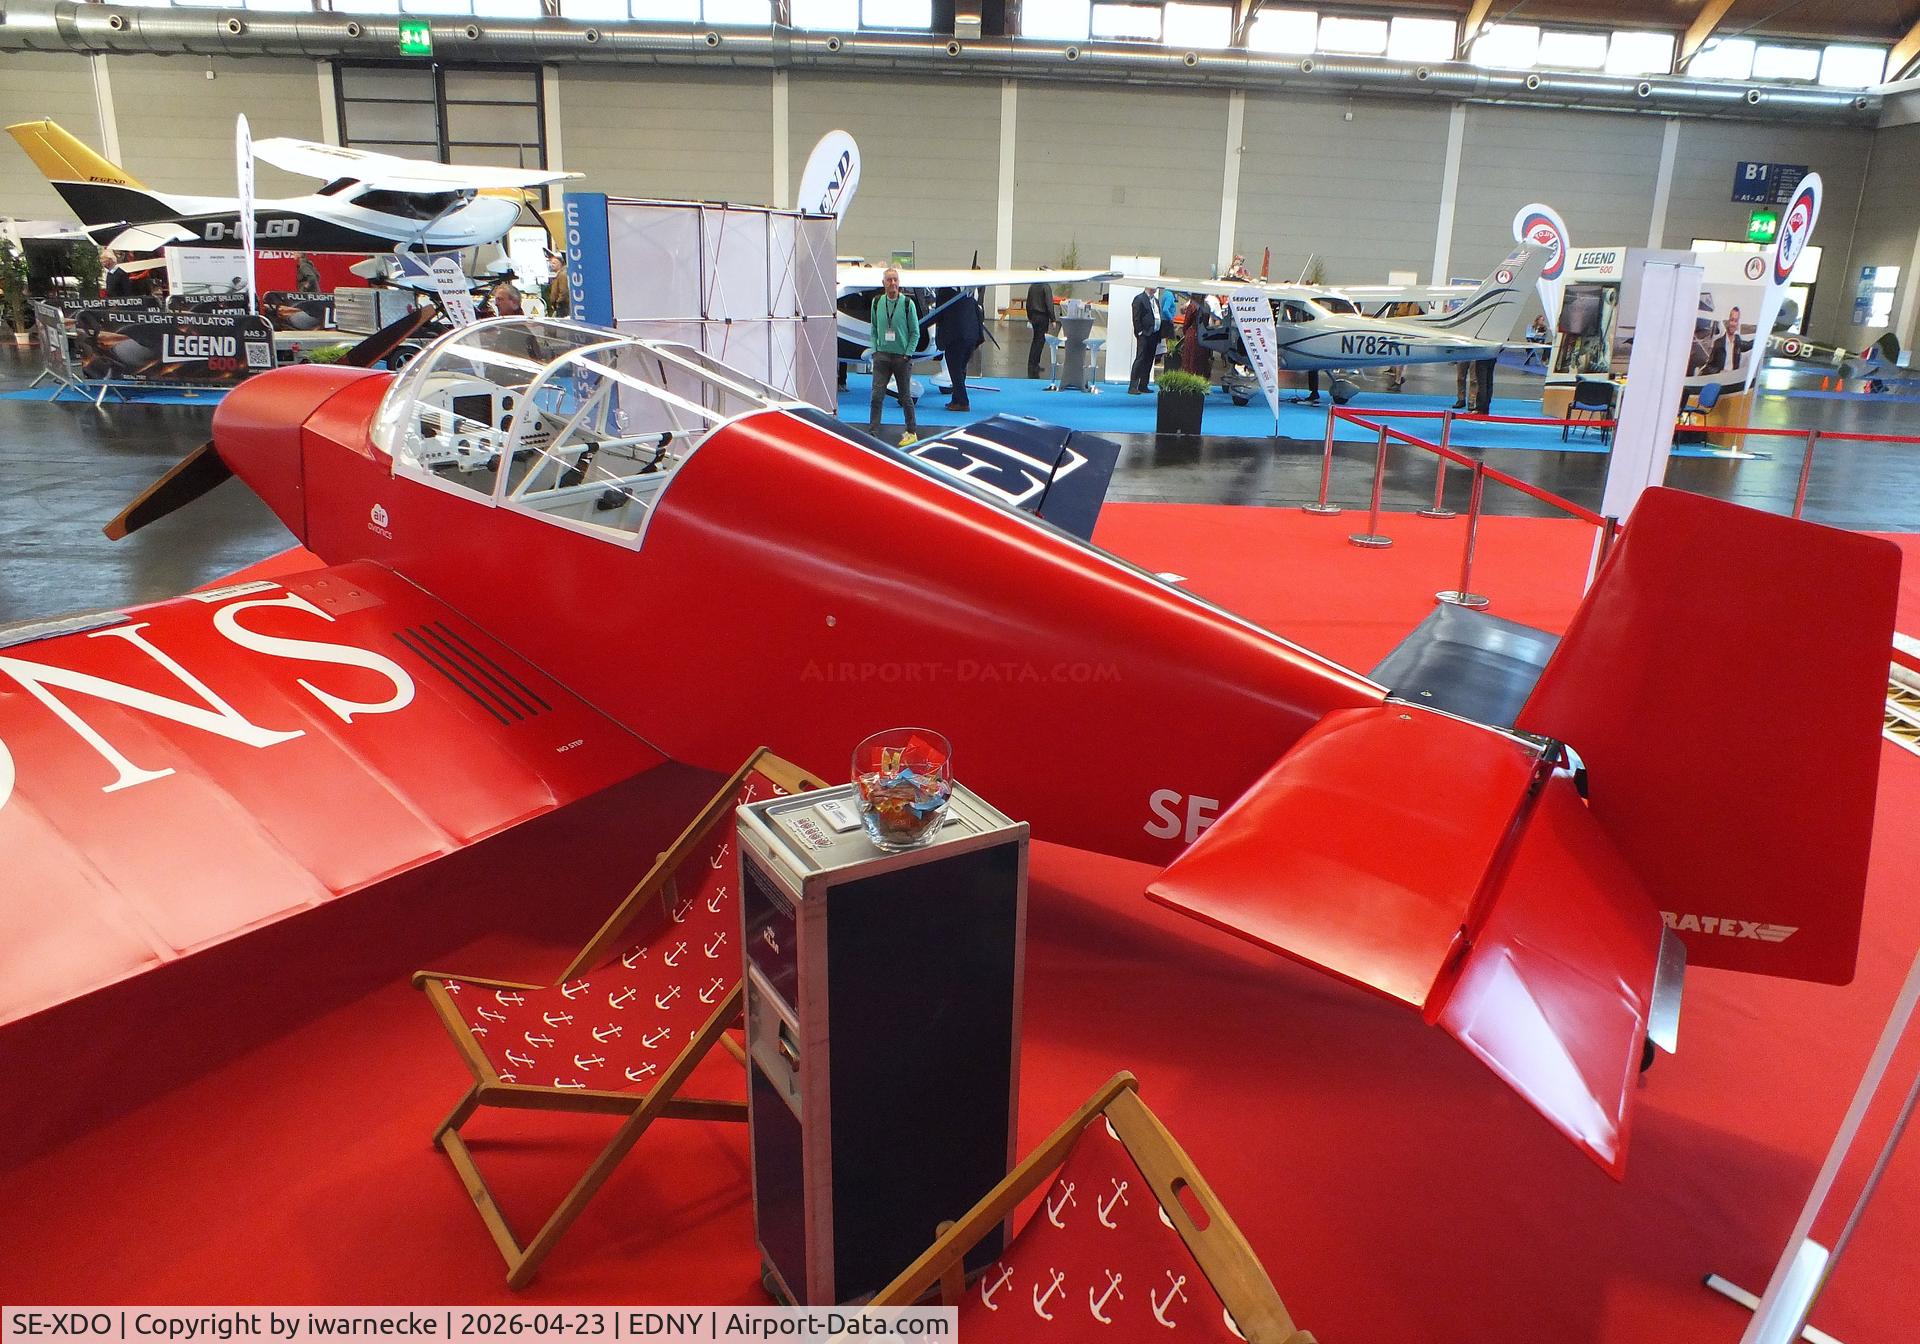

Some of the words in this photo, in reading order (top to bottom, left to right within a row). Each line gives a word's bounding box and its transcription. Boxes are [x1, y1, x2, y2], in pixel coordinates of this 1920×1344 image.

[1745, 164, 1768, 180] B1
[1575, 252, 1616, 270] LEGEND
[1600, 266, 1613, 274] 600
[64, 300, 82, 309] FULL
[108, 298, 143, 307] SIMULATOR
[109, 313, 134, 324] FULL
[138, 315, 173, 325] FLIGHT
[177, 316, 234, 327] SIMULATOR
[162, 334, 237, 364] LEGEND
[208, 358, 237, 371] 600
[374, 510, 385, 523] air
[556, 745, 569, 753] NO
[567, 739, 584, 749] STEP
[1143, 788, 1219, 844] SE
